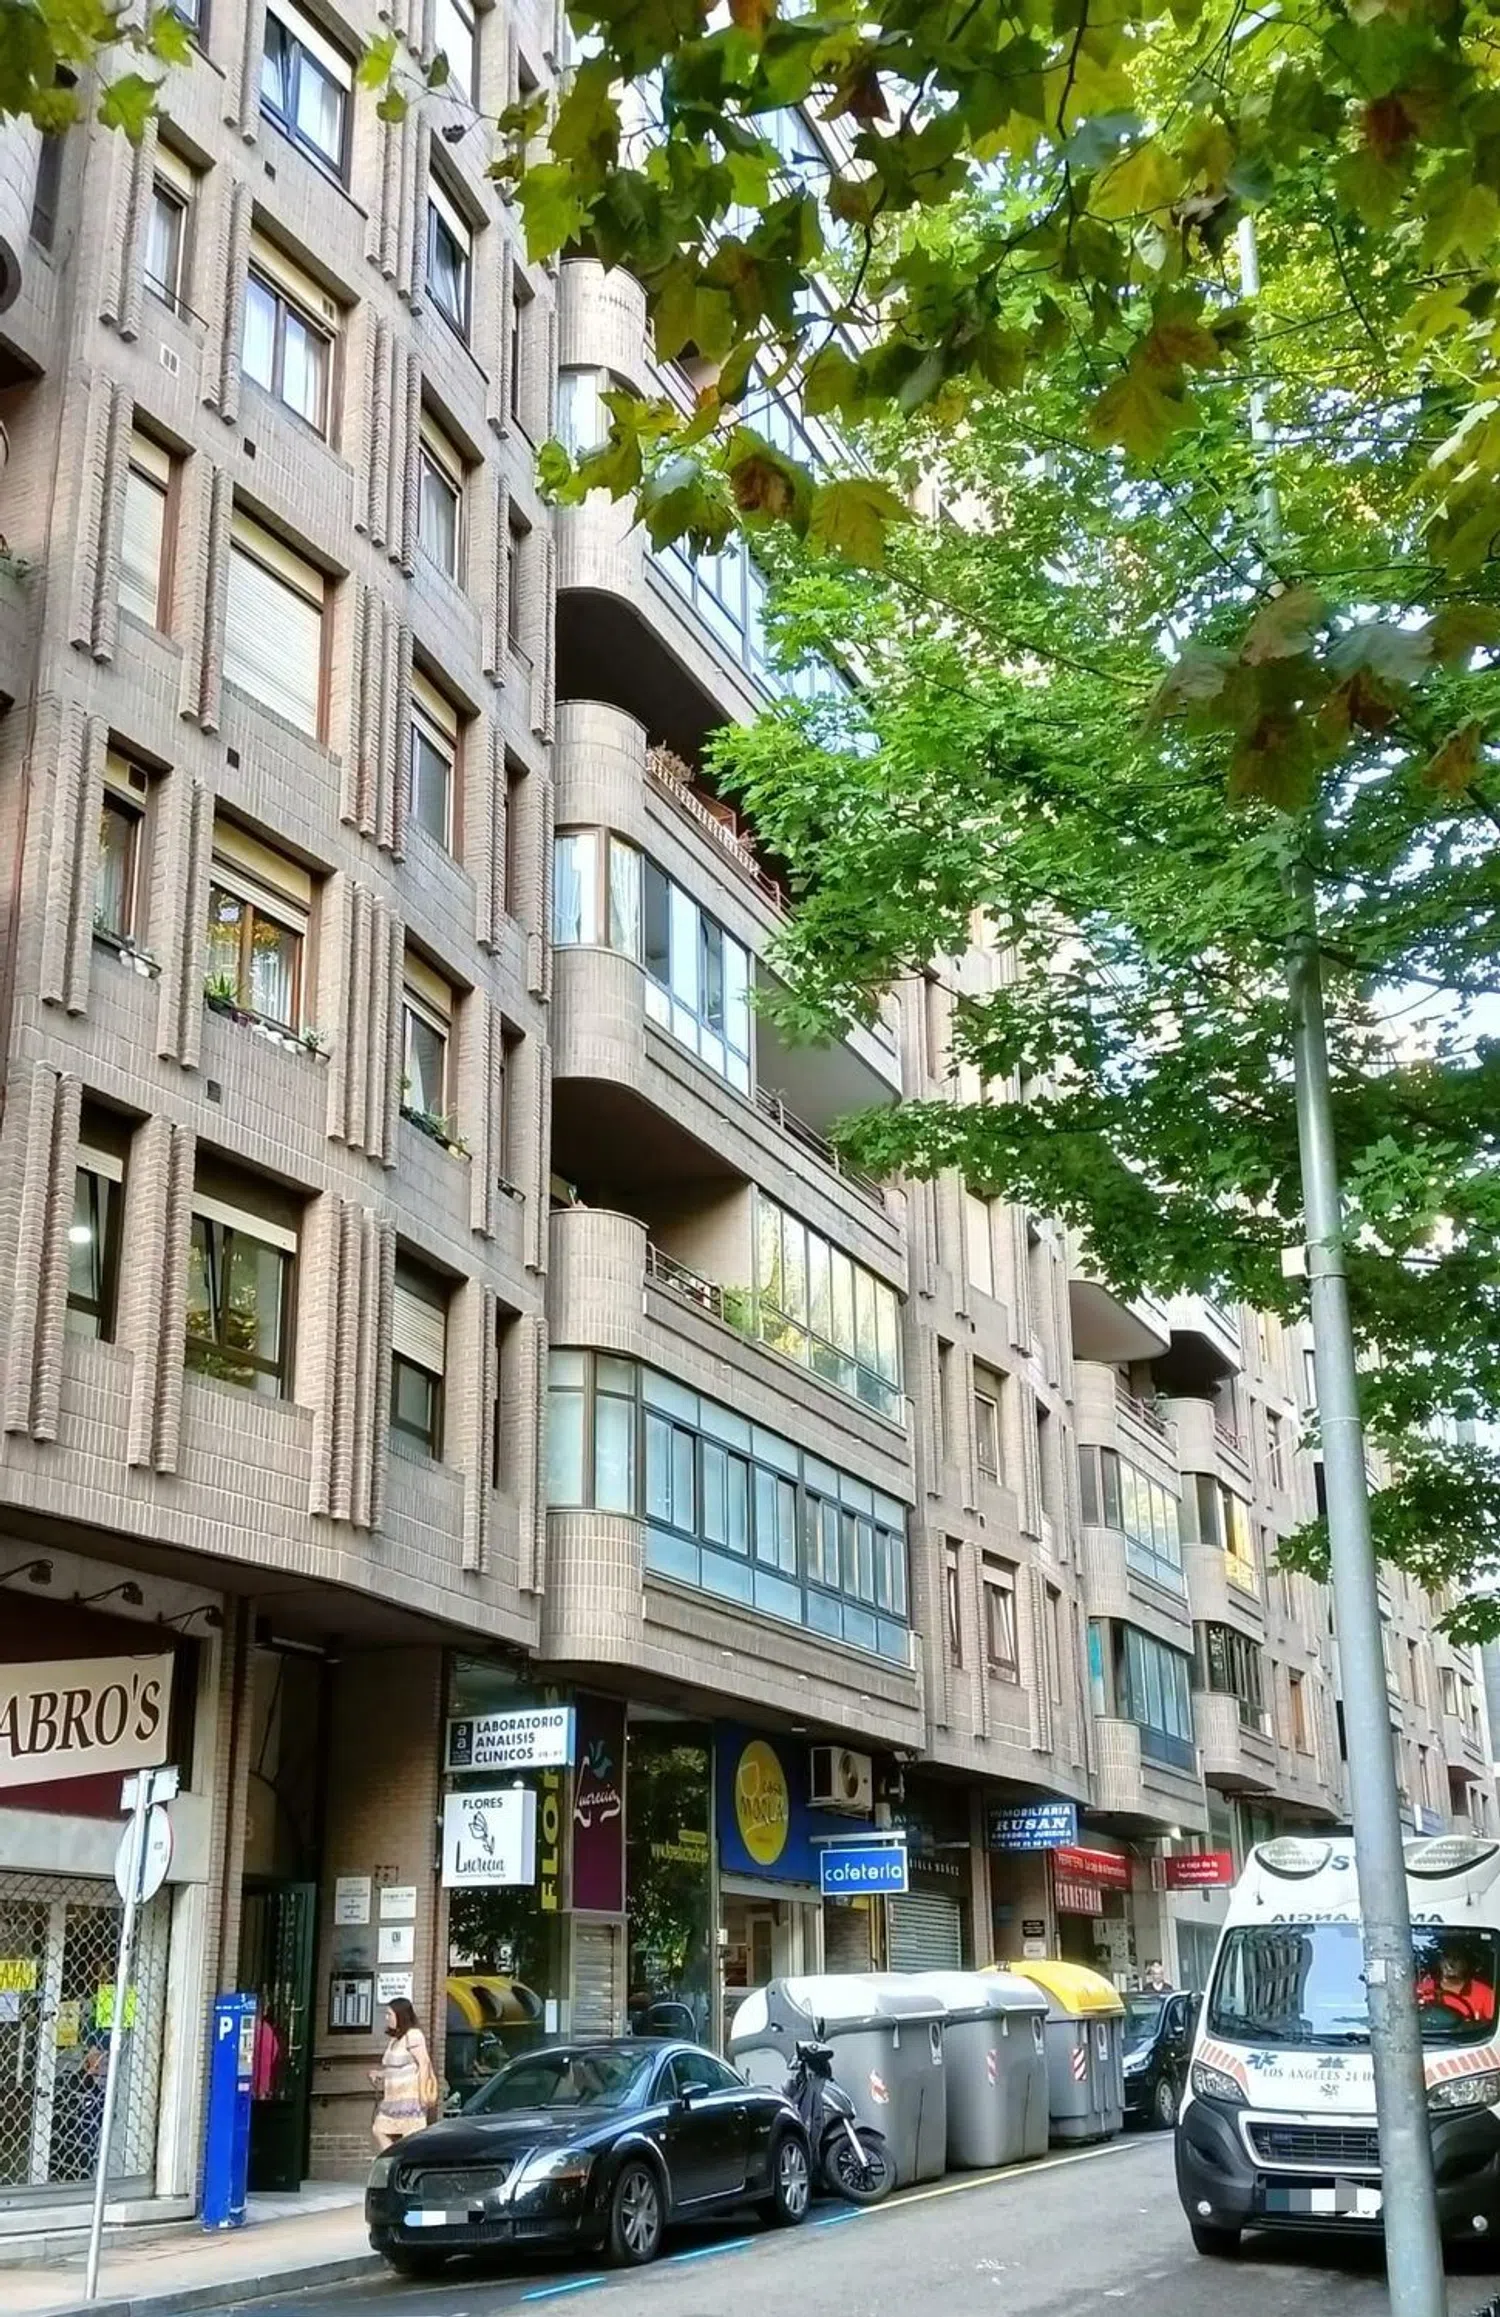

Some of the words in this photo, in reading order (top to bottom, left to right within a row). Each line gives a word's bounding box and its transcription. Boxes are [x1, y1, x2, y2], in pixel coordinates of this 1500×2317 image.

[476, 1715, 564, 1733] LABORATORIO
[475, 1732, 536, 1748] ANALISIS
[474, 1747, 535, 1763] CLINICOS
[462, 1797, 503, 1810] FLORES
[990, 1805, 1071, 1818] INMOBILIARIA
[996, 1817, 1068, 1832] RUSAN
[219, 2015, 233, 2041] P
[1263, 2068, 1284, 2078] LOS
[1288, 2069, 1341, 2081] ANGELES
